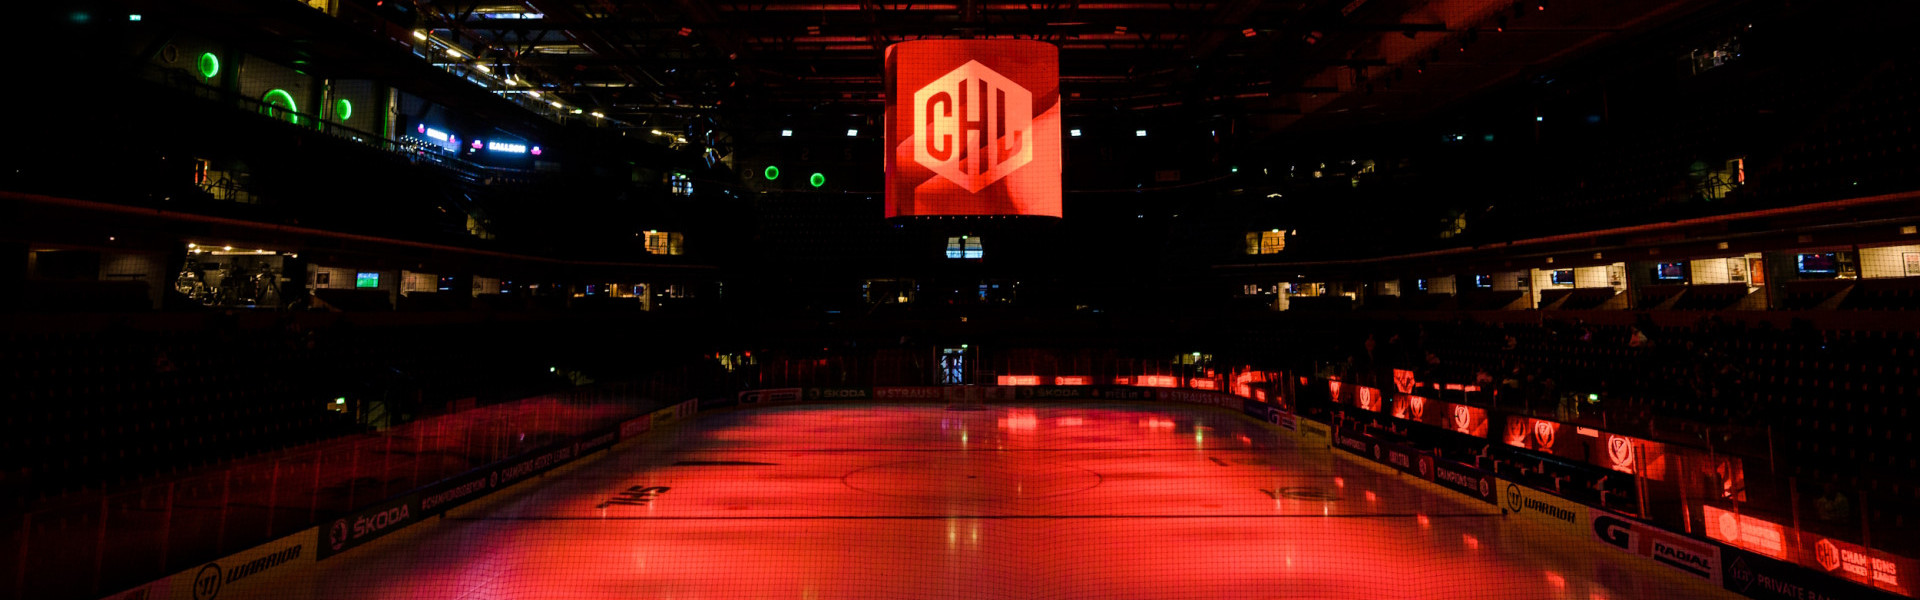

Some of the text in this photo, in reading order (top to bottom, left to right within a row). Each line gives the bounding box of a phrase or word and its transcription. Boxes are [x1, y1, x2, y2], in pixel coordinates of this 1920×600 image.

[926, 78, 1023, 176] CHL
[1524, 496, 1576, 524] WARRIOR
[226, 544, 302, 584] WARRIOR
[1655, 542, 1711, 570] RADIAL
[1817, 542, 1838, 570] CHL
[1841, 549, 1896, 575] CHAMIONS
[1757, 573, 1805, 600] PRIVATE
